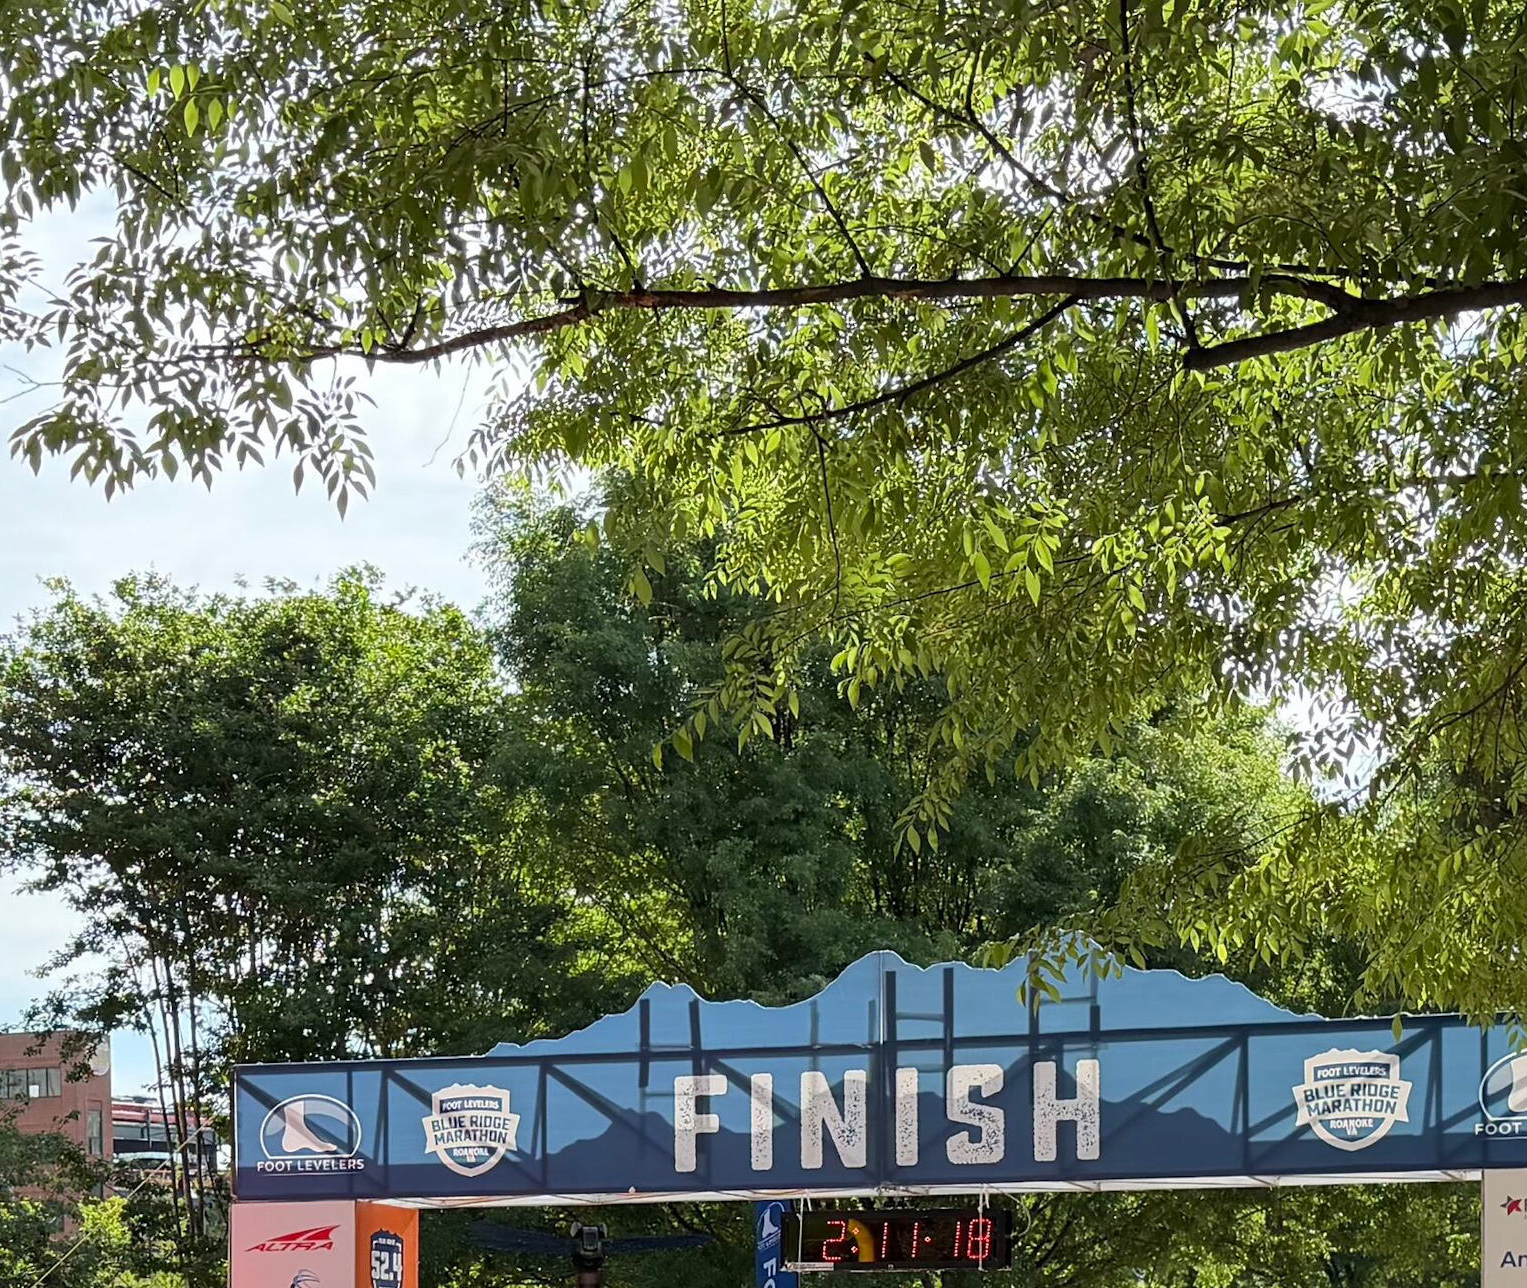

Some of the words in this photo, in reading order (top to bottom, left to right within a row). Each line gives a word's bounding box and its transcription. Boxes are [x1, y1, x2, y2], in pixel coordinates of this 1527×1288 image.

[1317, 1067, 1342, 1079] FOOT
[1303, 1083, 1346, 1103] BLUE
[1350, 1082, 1401, 1100] RIDGE
[442, 1100, 464, 1111] FOOT
[1306, 1098, 1397, 1117] MARATHON
[431, 1115, 466, 1132] BLUE
[470, 1115, 511, 1131] RIDGE
[673, 1058, 1101, 1173] FINISH
[434, 1129, 508, 1146] MARATHON
[1475, 1122, 1522, 1136] FOOT
[257, 1160, 292, 1172] FOOT
[297, 1158, 365, 1171] LEVELERS
[244, 1241, 334, 1252] ALTRA
[371, 1250, 403, 1281] 52.4
